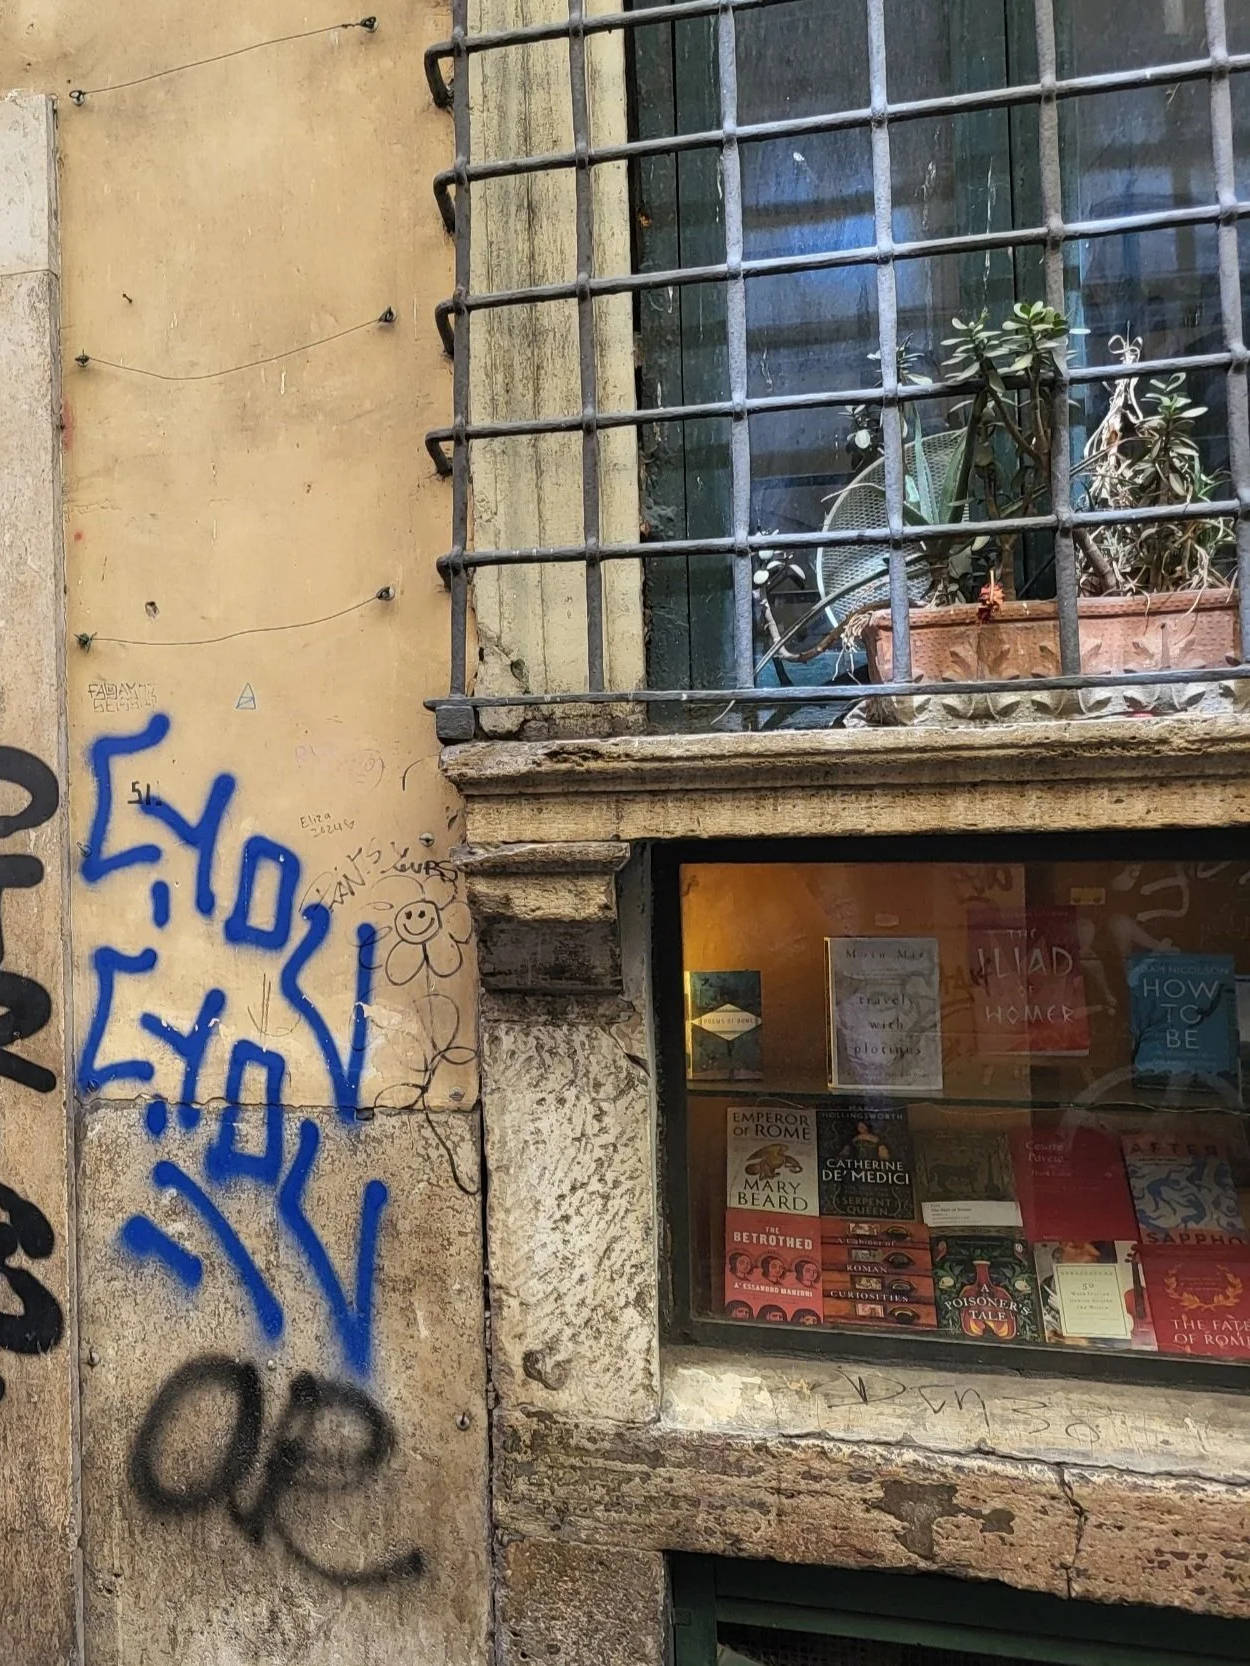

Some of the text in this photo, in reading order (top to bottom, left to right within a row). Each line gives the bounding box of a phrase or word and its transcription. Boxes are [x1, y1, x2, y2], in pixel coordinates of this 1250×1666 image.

[977, 947, 1074, 978] ILIAD
[1142, 978, 1219, 999] HOW
[985, 1005, 1075, 1024] HOMER
[1160, 1003, 1202, 1024] TO
[870, 1016, 904, 1030] with
[1166, 1029, 1199, 1049] BE
[733, 1112, 810, 1127] EMPEROR
[755, 1123, 811, 1141] ROME
[826, 1158, 904, 1171] CATHERINE
[852, 1170, 910, 1185] MEDICI
[744, 1178, 801, 1195] MARY
[737, 1191, 809, 1212] BEARD
[842, 1196, 890, 1206] SERPENT
[847, 1206, 888, 1215] QUEEN
[765, 1226, 780, 1234] THE
[733, 1231, 813, 1250] BETROTHED
[847, 1264, 888, 1273] ROMAN
[781, 1287, 813, 1297] MANZONI
[981, 1283, 990, 1292] A
[1082, 1282, 1095, 1291] 50
[830, 1290, 910, 1303] CURIOSITIES
[945, 1297, 1033, 1316] POISONER'S
[969, 1310, 1008, 1322] TALE
[1174, 1319, 1206, 1330] THE
[1174, 1333, 1197, 1345] OF
